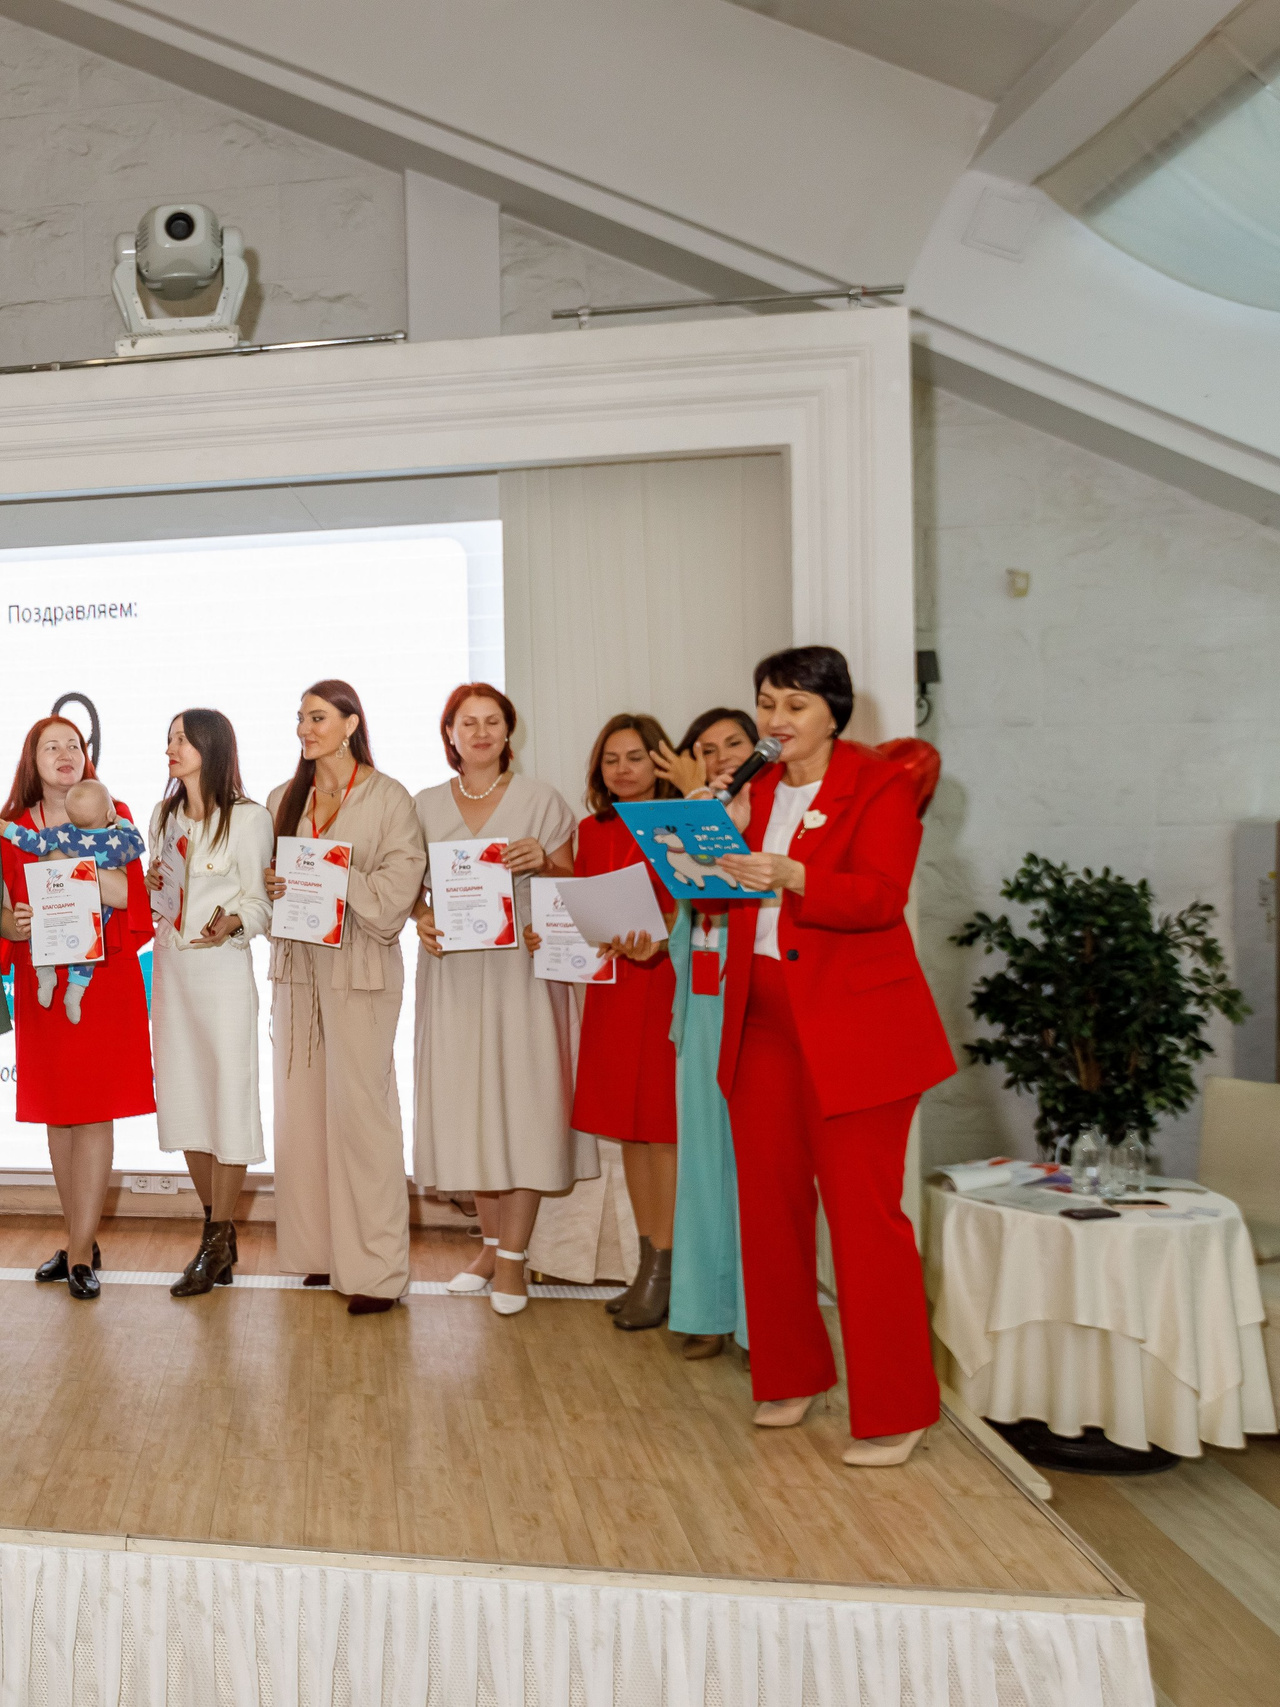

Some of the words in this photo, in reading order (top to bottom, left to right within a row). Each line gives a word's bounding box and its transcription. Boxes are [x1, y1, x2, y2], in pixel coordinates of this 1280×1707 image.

[8, 602, 138, 627] Поздравляем:
[288, 879, 323, 888] БЛАГОДАРИМ
[446, 885, 483, 893] БЛАГОДАРИМ
[42, 902, 76, 910] БЛАГОДАРИМ
